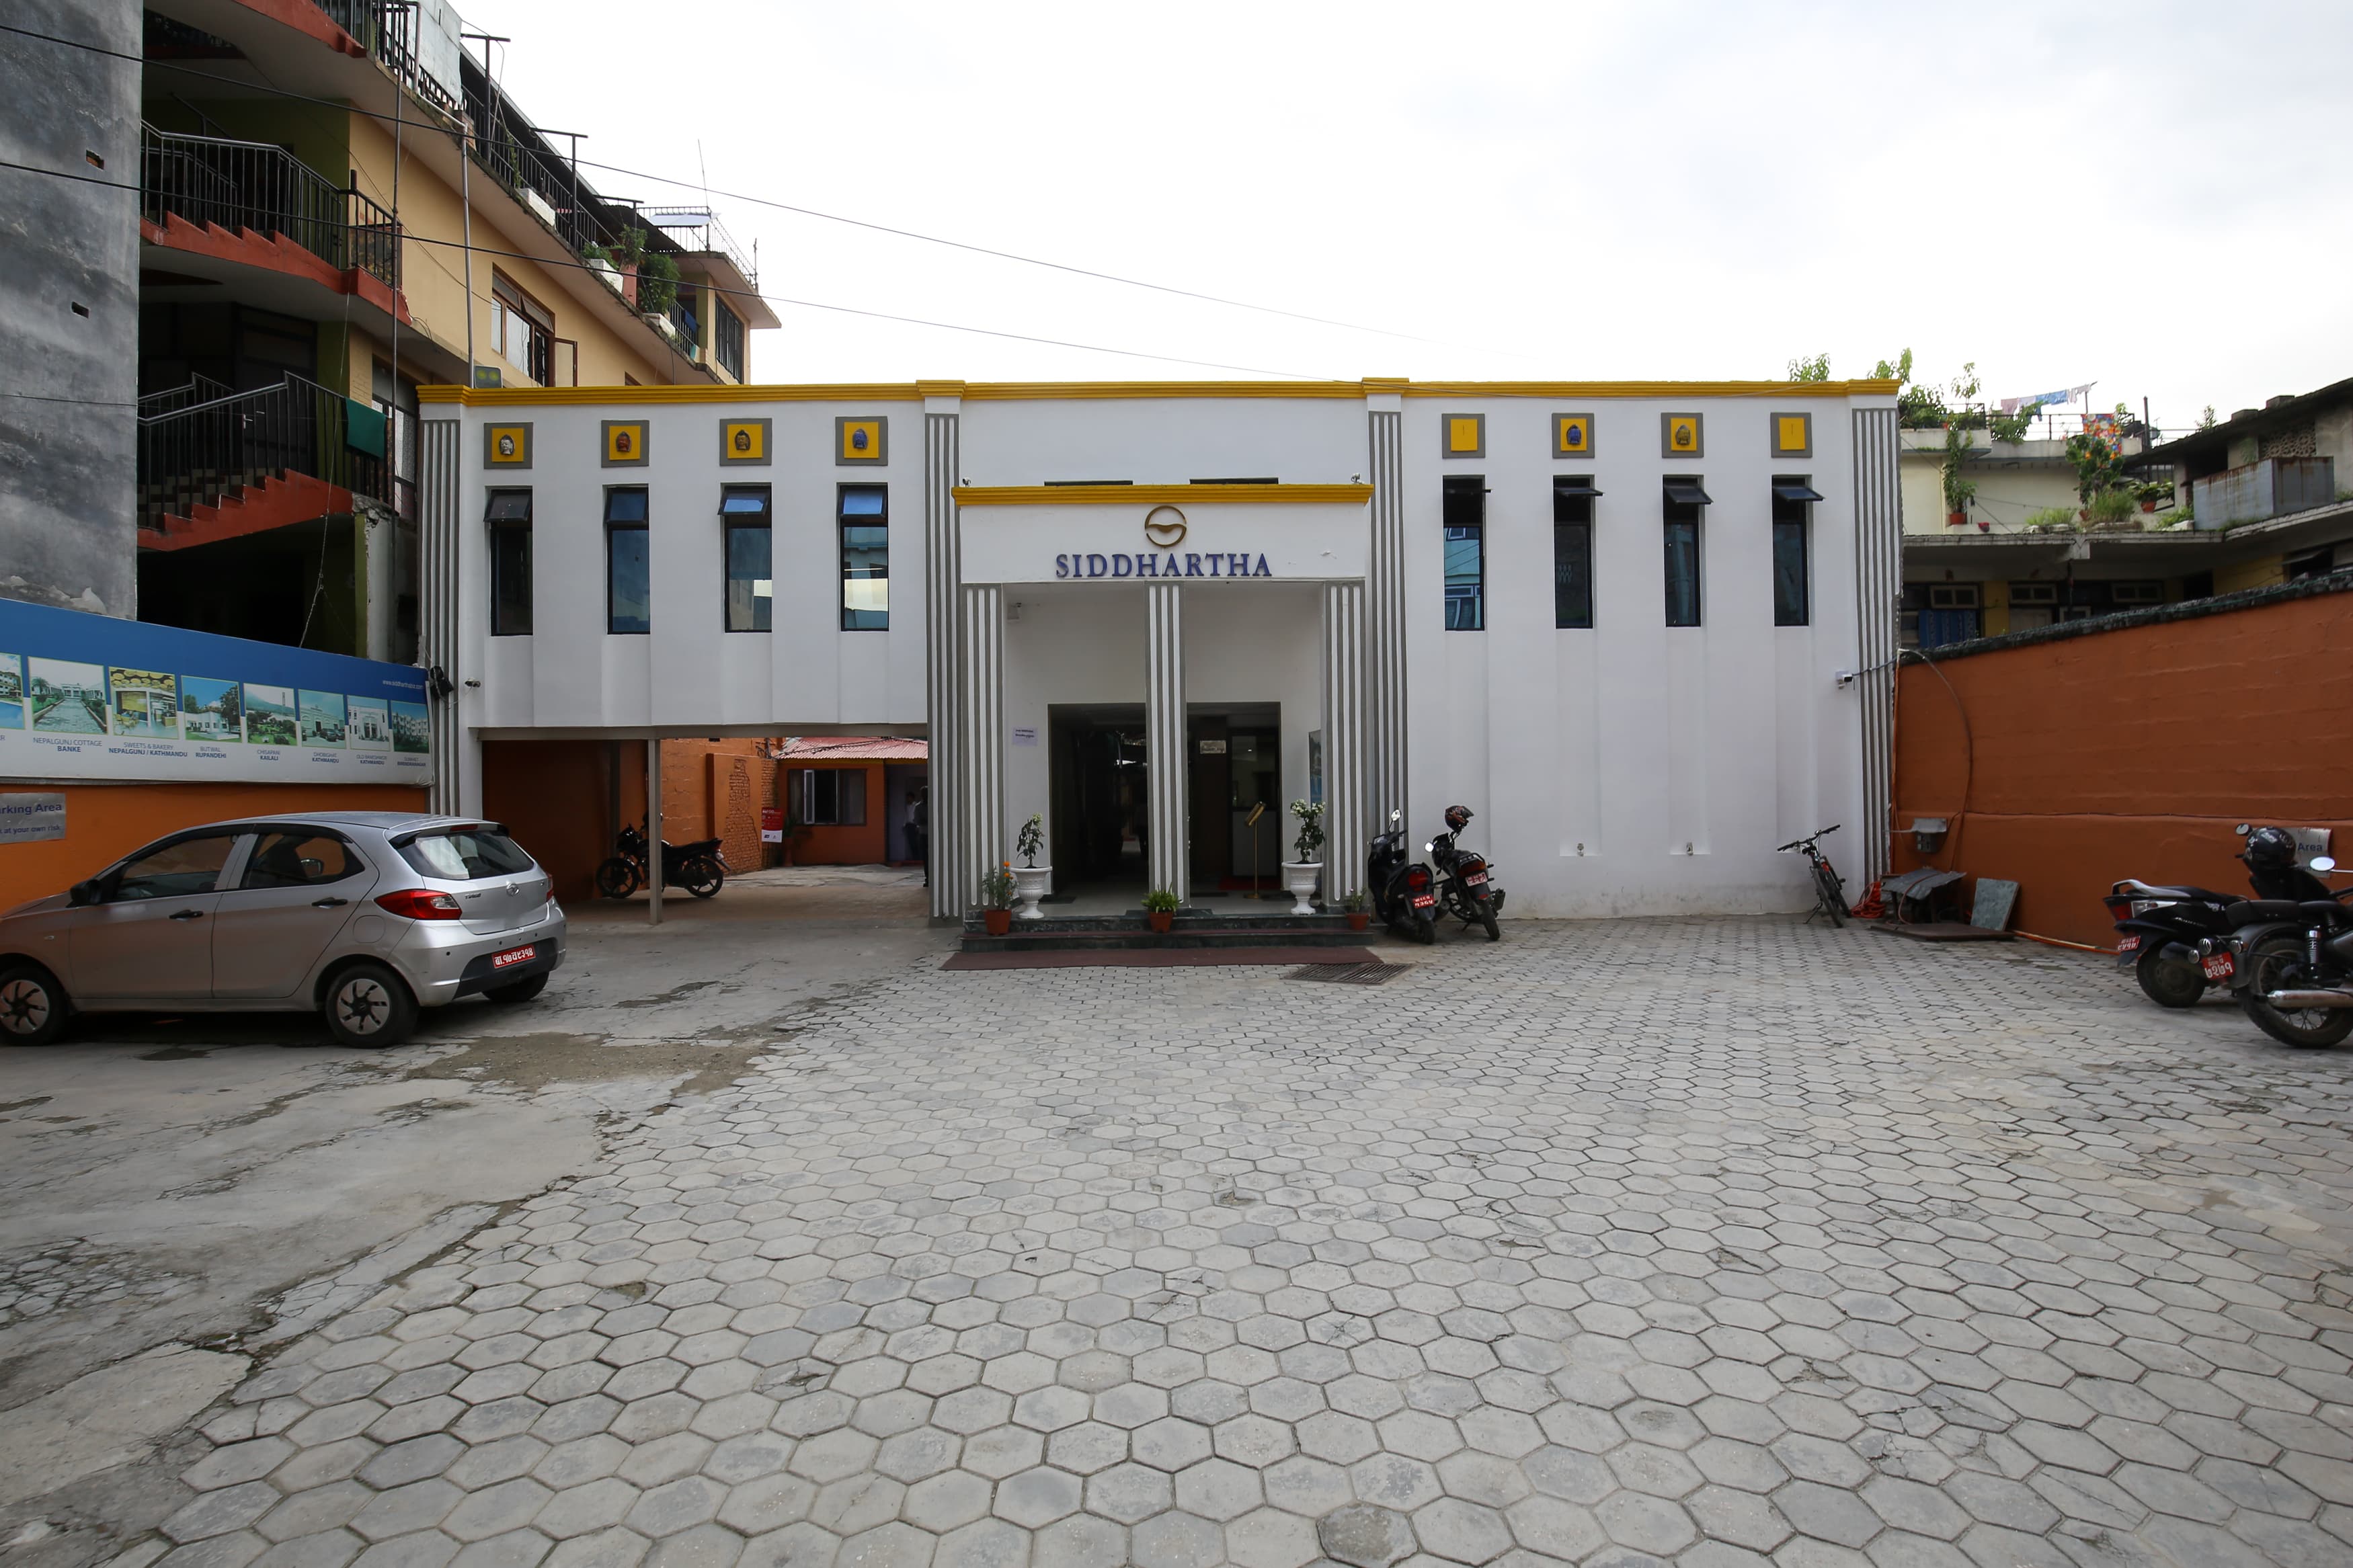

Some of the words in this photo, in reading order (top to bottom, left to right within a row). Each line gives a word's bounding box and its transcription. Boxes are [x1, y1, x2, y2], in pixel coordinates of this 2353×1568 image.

[1056, 553, 1272, 577] SIDDHARTHA
[34, 737, 72, 745] NEPALGUNJ
[150, 749, 188, 757] KATHMANDU
[34, 803, 62, 813] Area
[12, 827, 29, 835] your
[2298, 843, 2323, 852] Area
